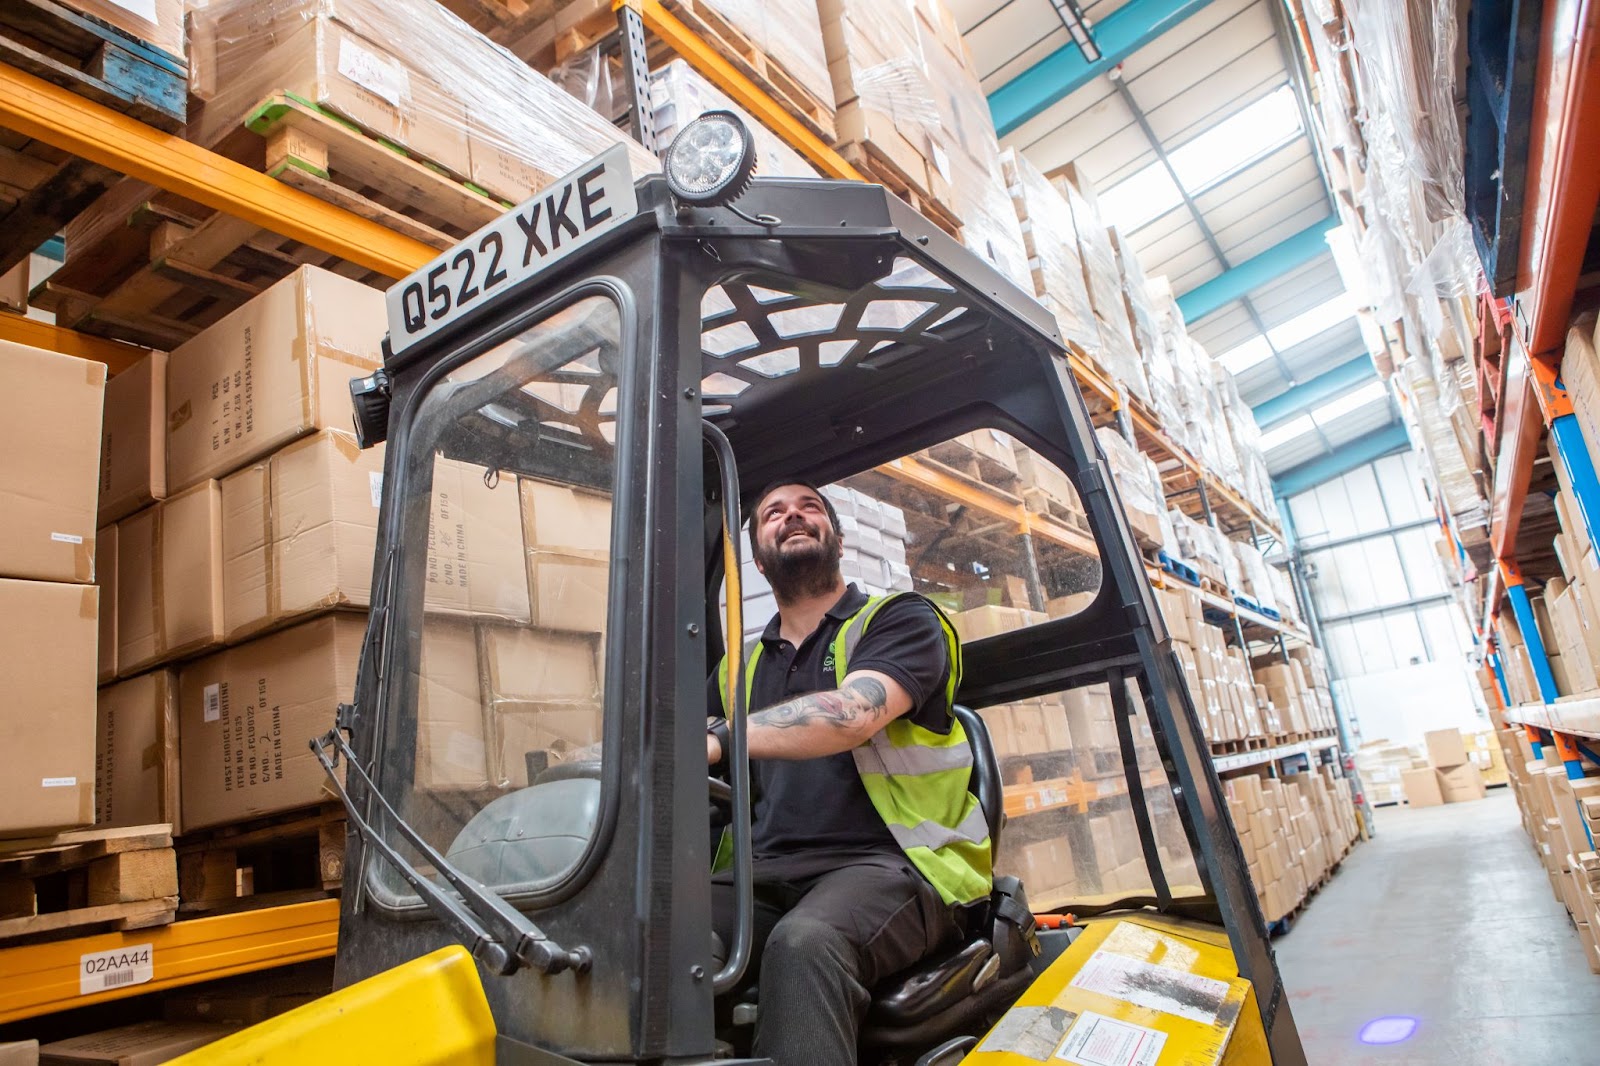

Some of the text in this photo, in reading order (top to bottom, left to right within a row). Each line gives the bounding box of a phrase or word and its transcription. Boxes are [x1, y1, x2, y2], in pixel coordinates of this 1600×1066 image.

[402, 162, 612, 334] Q522 XKE
[222, 376, 230, 394] KGS
[456, 524, 468, 588] MADE IN CHINA
[430, 572, 438, 584] PO
[222, 682, 232, 792] FIRST CHOICE LIGHTING
[259, 732, 271, 744] 2
[272, 705, 282, 780] MADE IN CHINA
[236, 766, 244, 788] ITEM
[250, 773, 257, 786] PO
[86, 950, 149, 974] 02AA44
